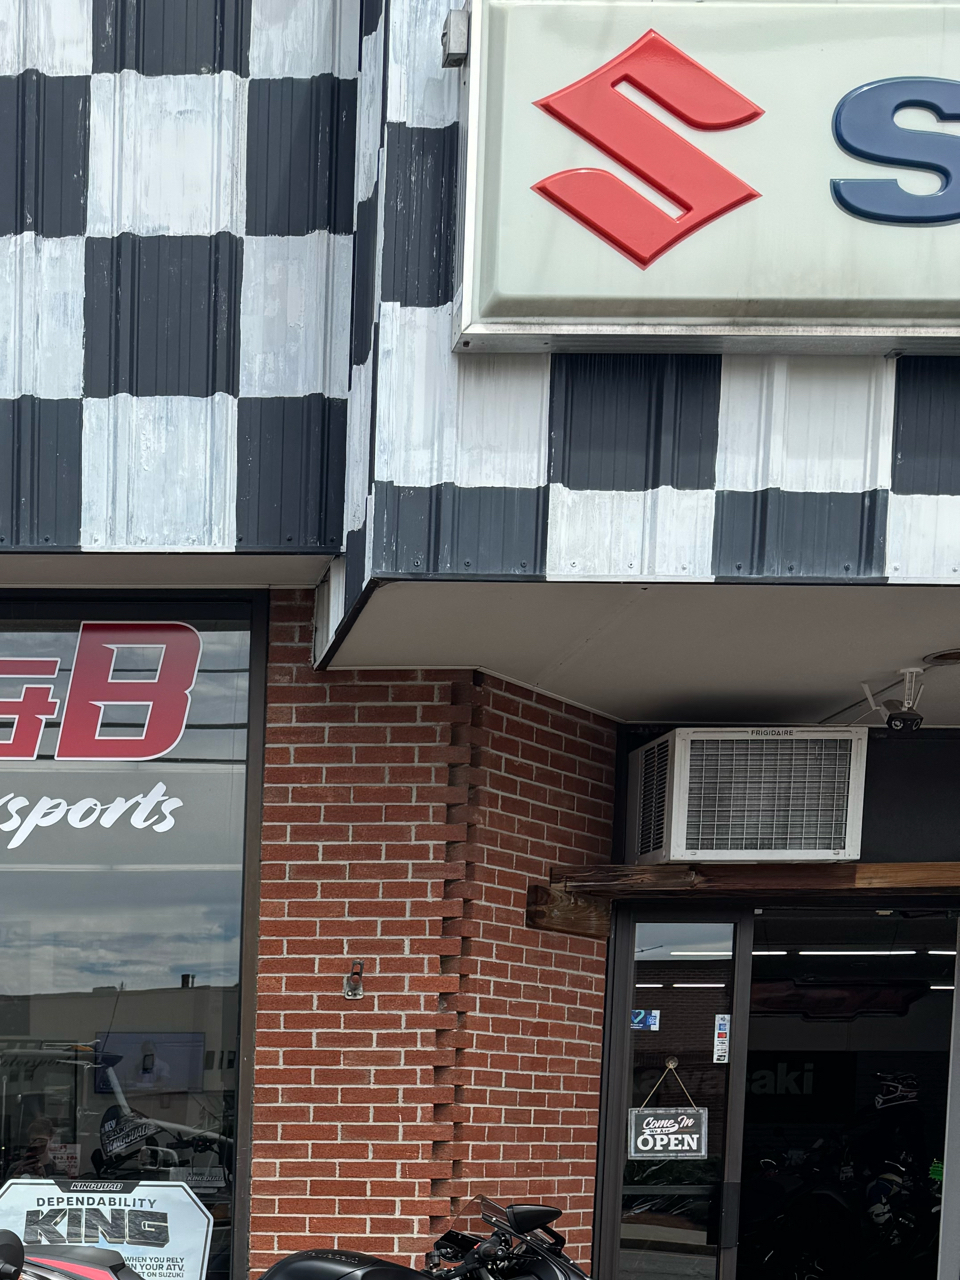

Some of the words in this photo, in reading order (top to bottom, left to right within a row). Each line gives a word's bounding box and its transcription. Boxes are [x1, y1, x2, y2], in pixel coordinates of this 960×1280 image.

[643, 1117, 675, 1129] Come
[678, 1115, 695, 1127] In
[637, 1134, 699, 1150] OPEN
[70, 1182, 123, 1190] KINGQUAD
[36, 1196, 157, 1209] DEPENDABILITY
[23, 1207, 170, 1248] KING
[166, 1264, 185, 1272] ATV.
